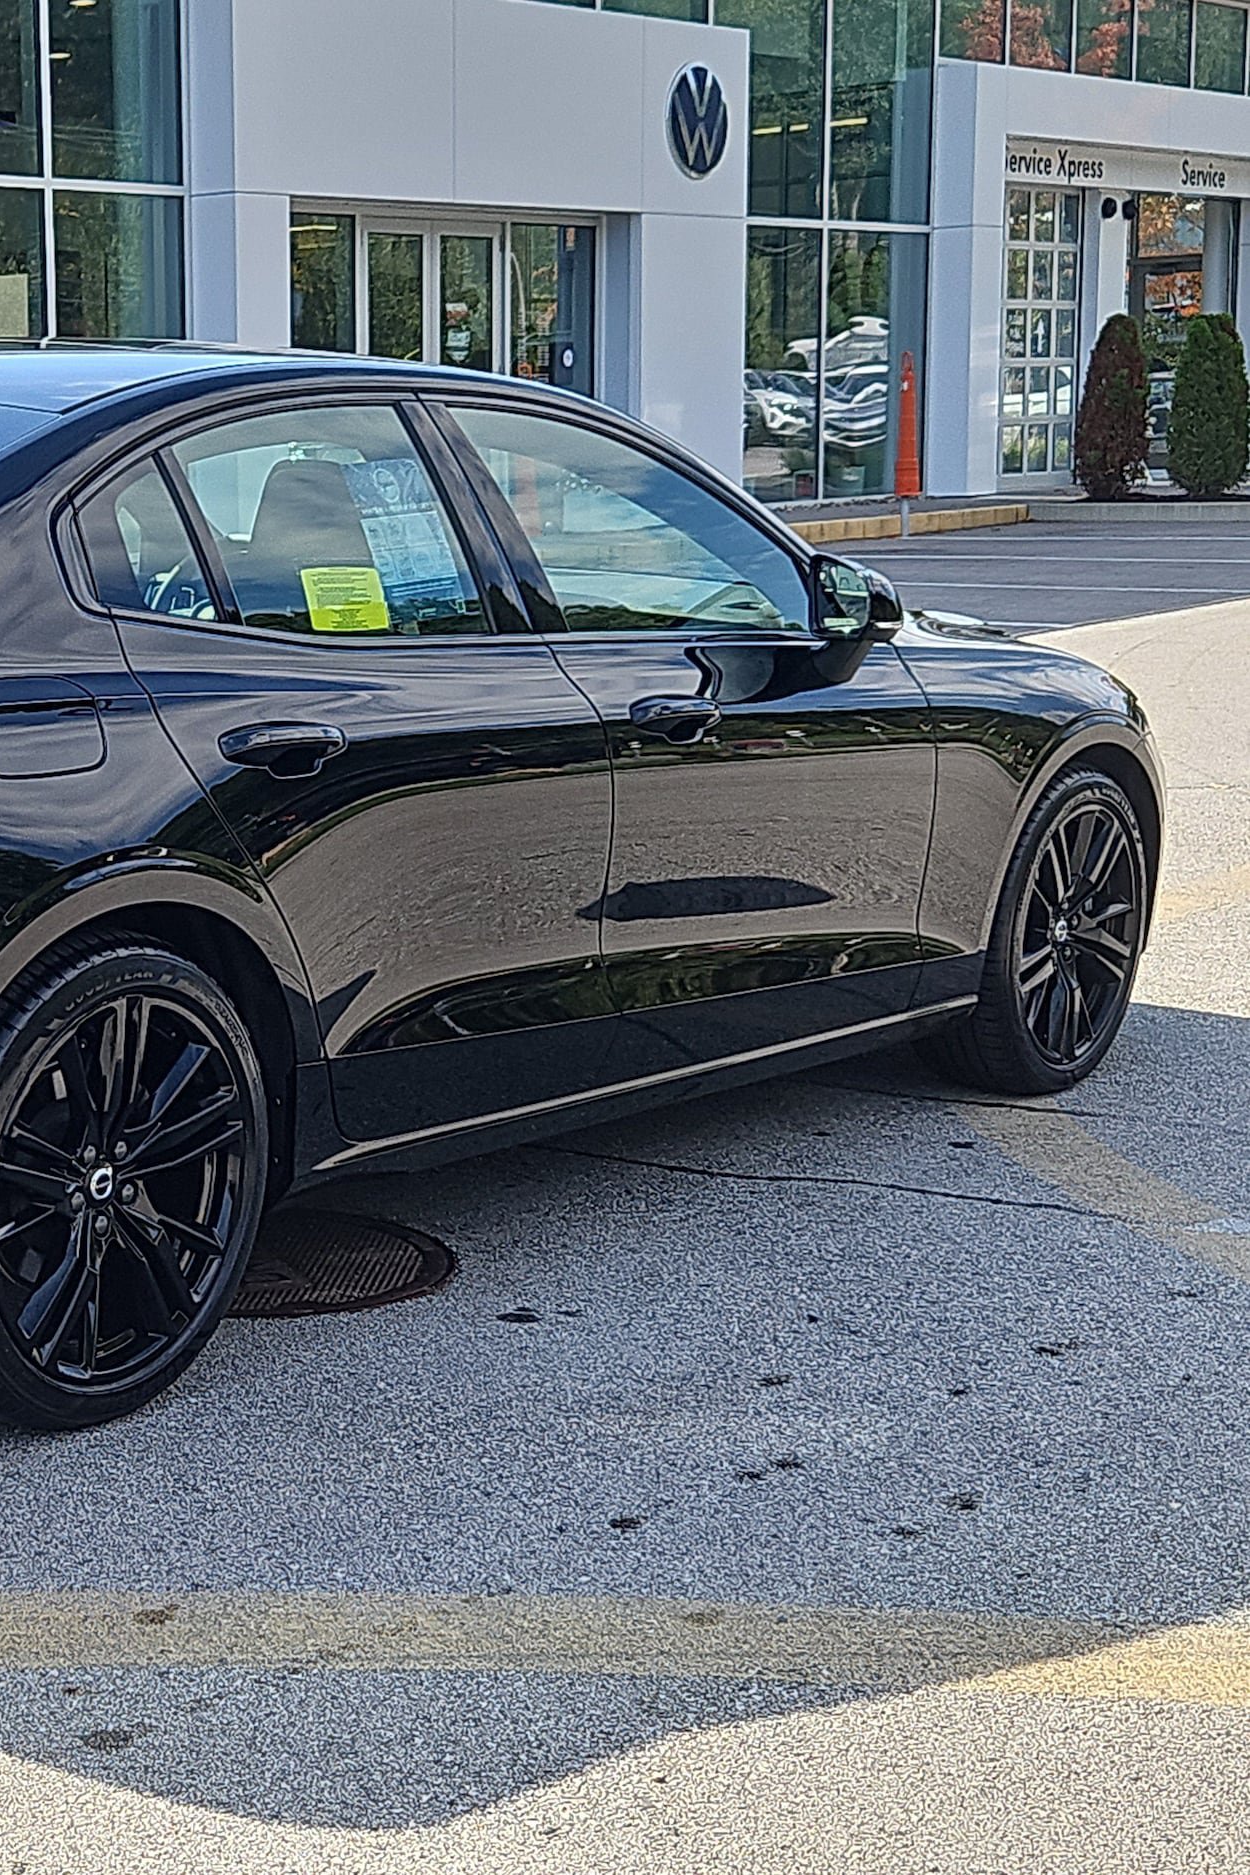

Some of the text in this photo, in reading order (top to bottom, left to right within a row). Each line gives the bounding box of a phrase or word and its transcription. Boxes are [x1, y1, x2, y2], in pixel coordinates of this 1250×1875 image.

[1005, 147, 1104, 184] ervice Xpress
[1181, 159, 1226, 188] Service
